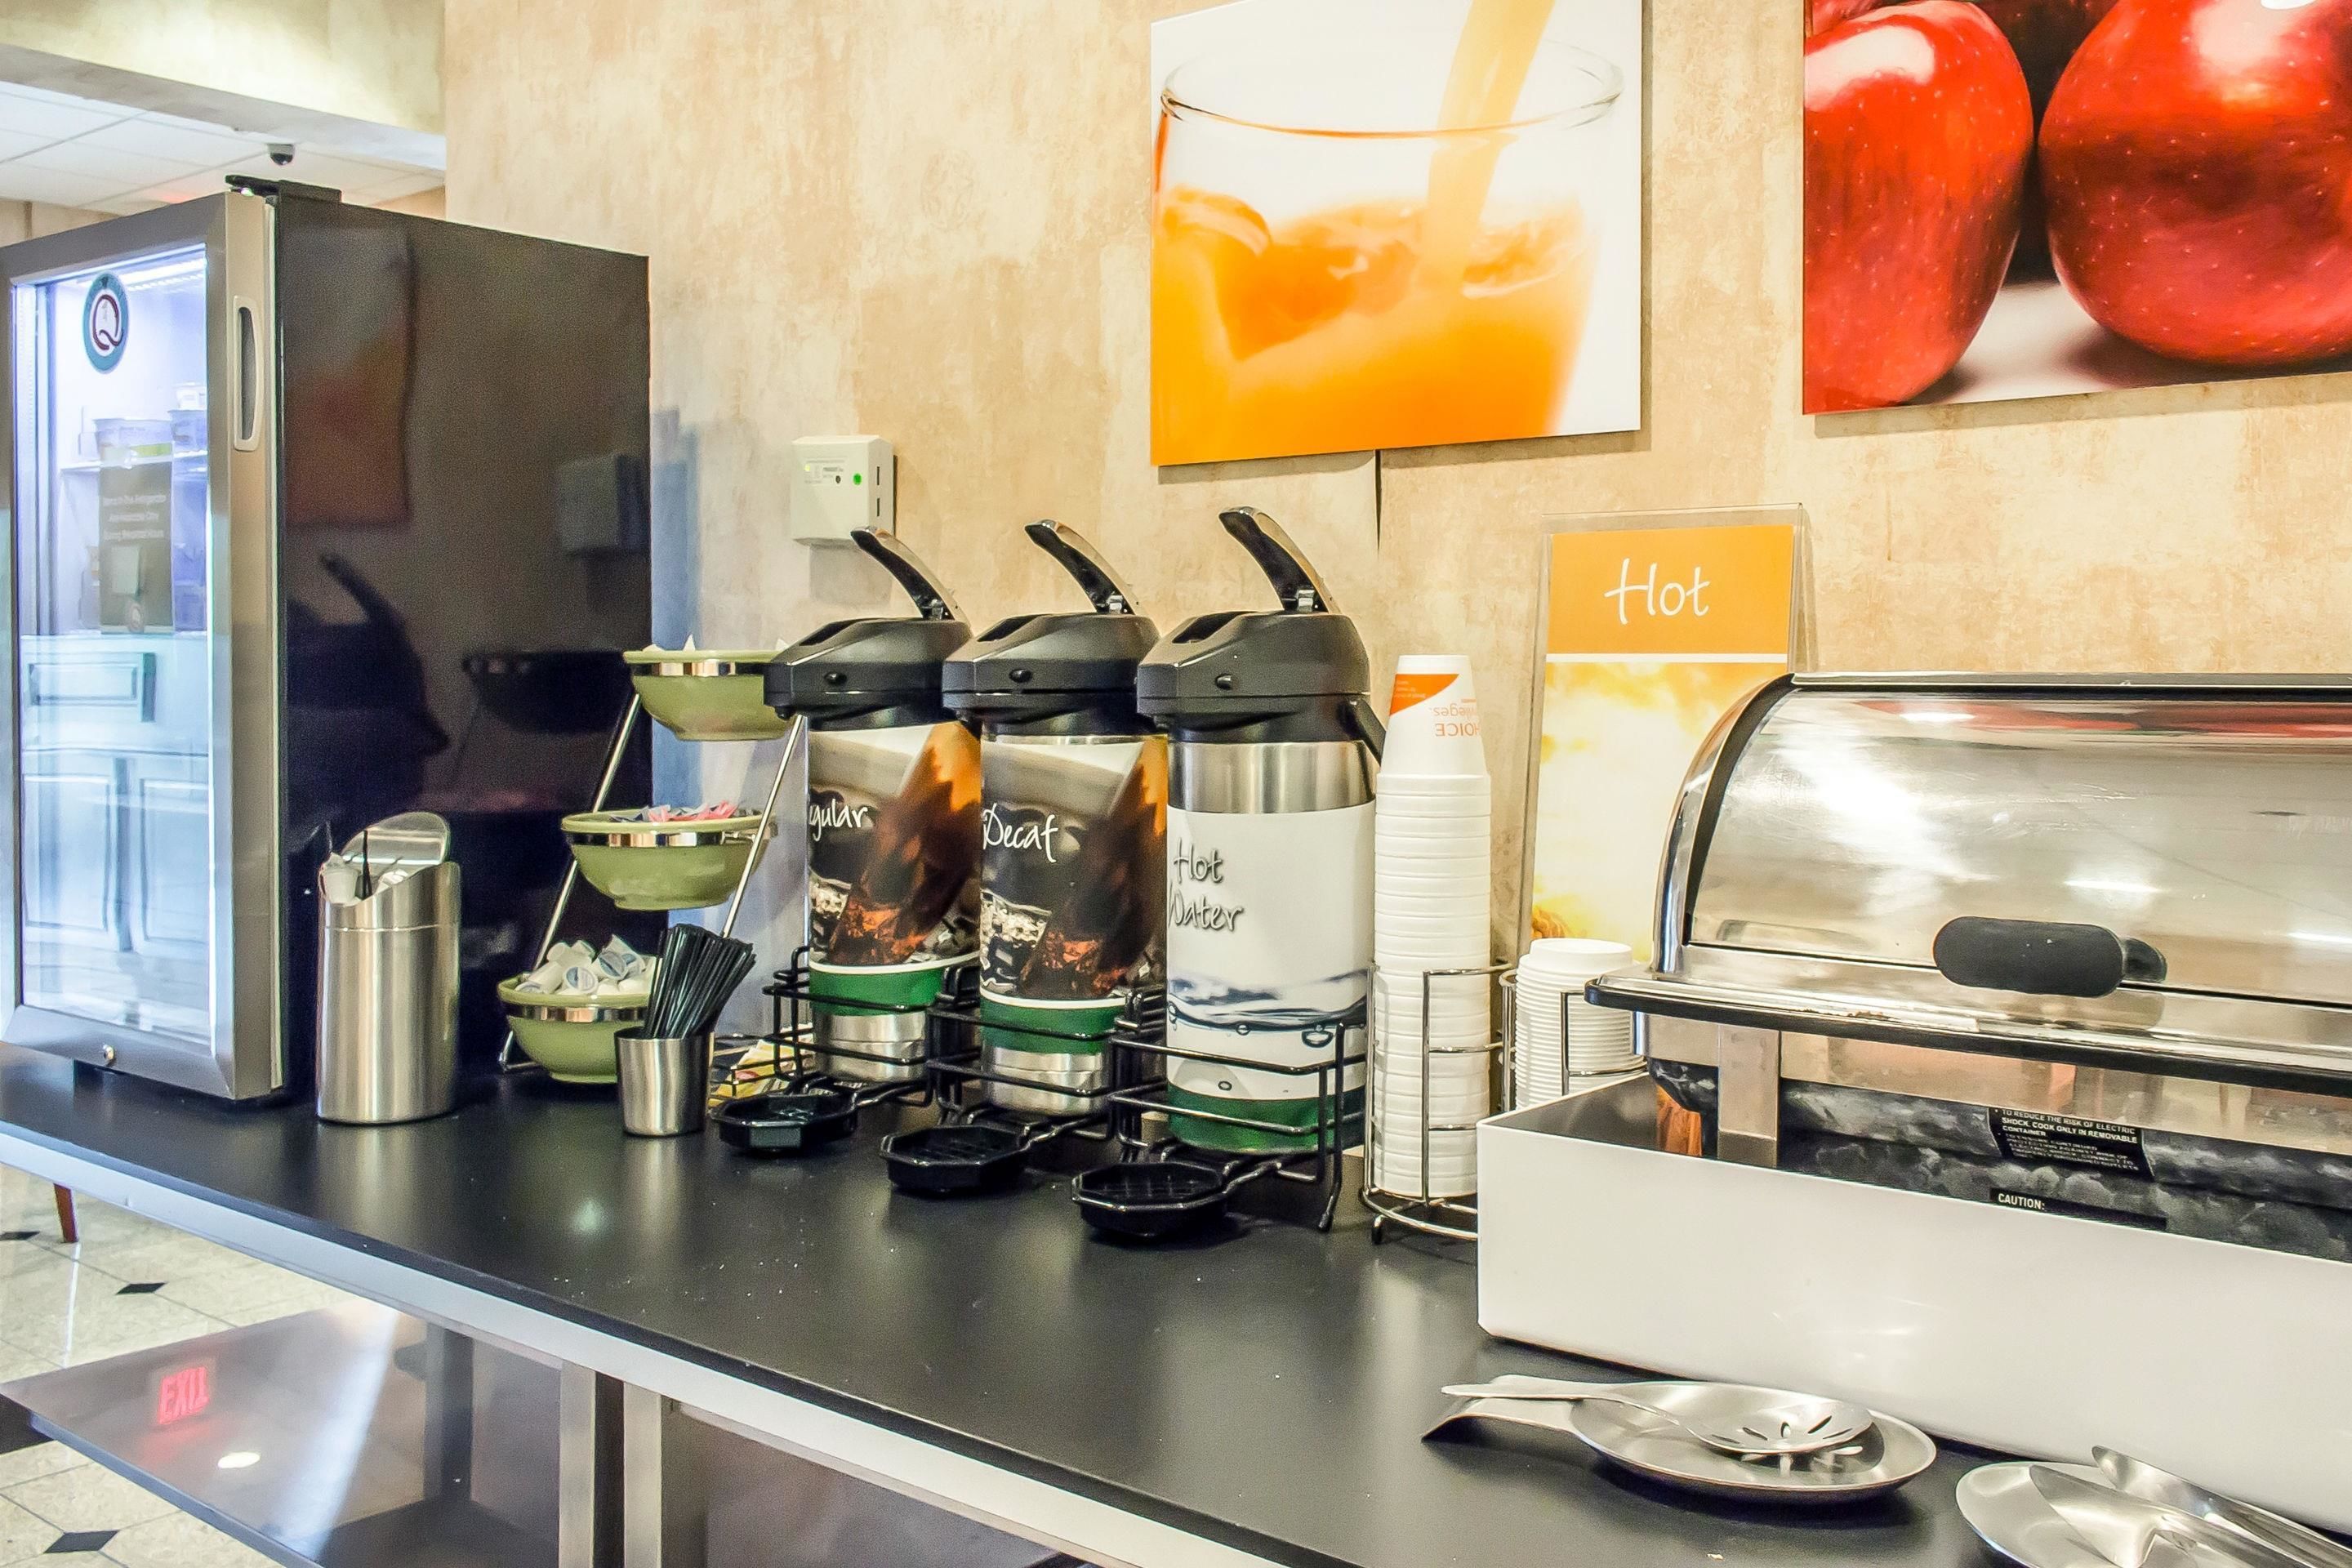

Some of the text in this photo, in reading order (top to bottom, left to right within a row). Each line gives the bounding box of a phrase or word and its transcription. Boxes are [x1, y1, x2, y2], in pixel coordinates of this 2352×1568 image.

[1604, 558, 1710, 625] Hot
[1435, 723, 1479, 737] HOICE
[981, 802, 1059, 863] Decaf
[1173, 837, 1223, 884] Hot
[2013, 1111, 2045, 1122] REDUCE
[2047, 1114, 2062, 1124] THE
[2063, 1117, 2082, 1127] RISK
[2083, 1120, 2094, 1129] OF
[2096, 1122, 2136, 1135] ELECTRIC
[2032, 1121, 2055, 1132] COOK
[2056, 1125, 2078, 1135] ONLY
[2078, 1129, 2087, 1137] IN
[2087, 1130, 2138, 1144] REMOVABLE
[1998, 1193, 2045, 1211] CAUTION:
